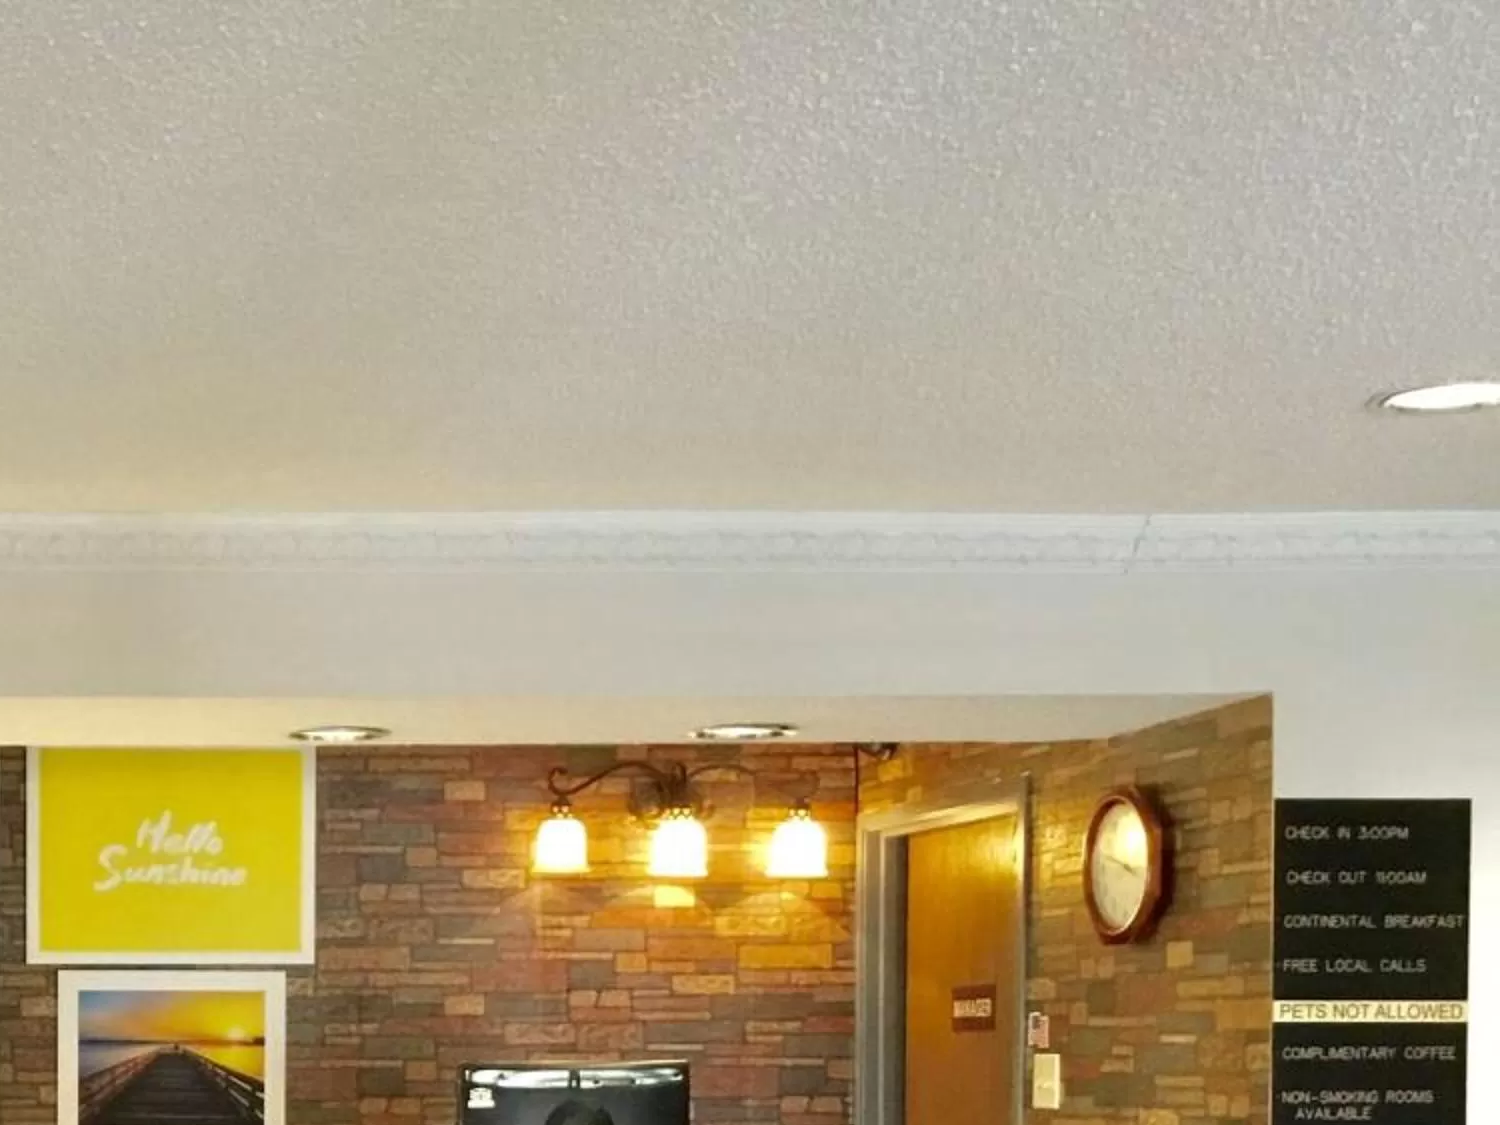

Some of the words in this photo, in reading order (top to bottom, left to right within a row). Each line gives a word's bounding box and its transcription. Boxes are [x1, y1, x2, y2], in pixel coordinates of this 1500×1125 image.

[135, 808, 224, 856] Hello
[1284, 825, 1330, 840] CHECK
[1336, 825, 1351, 840] IN
[92, 844, 248, 893] Sunshine
[1286, 870, 1331, 885] CHECK
[1338, 870, 1367, 885] OUT
[1283, 914, 1377, 929] CONTINENTAL
[1384, 914, 1464, 929] BREAKFAST
[1283, 958, 1319, 973] FREE
[1325, 958, 1372, 973] LOCAL
[1379, 958, 1427, 973] CALLS
[1279, 1003, 1327, 1020] PETS
[1332, 1003, 1373, 1020] NOT
[1374, 1003, 1464, 1020] ALLOWED
[1281, 1046, 1396, 1060] COMPLIMENTARY
[1403, 1046, 1457, 1060] COFFEE
[1281, 1090, 1379, 1104] NON-SMOKING
[1385, 1090, 1434, 1104] ROOMS
[1293, 1106, 1373, 1120] AVAILABLE
